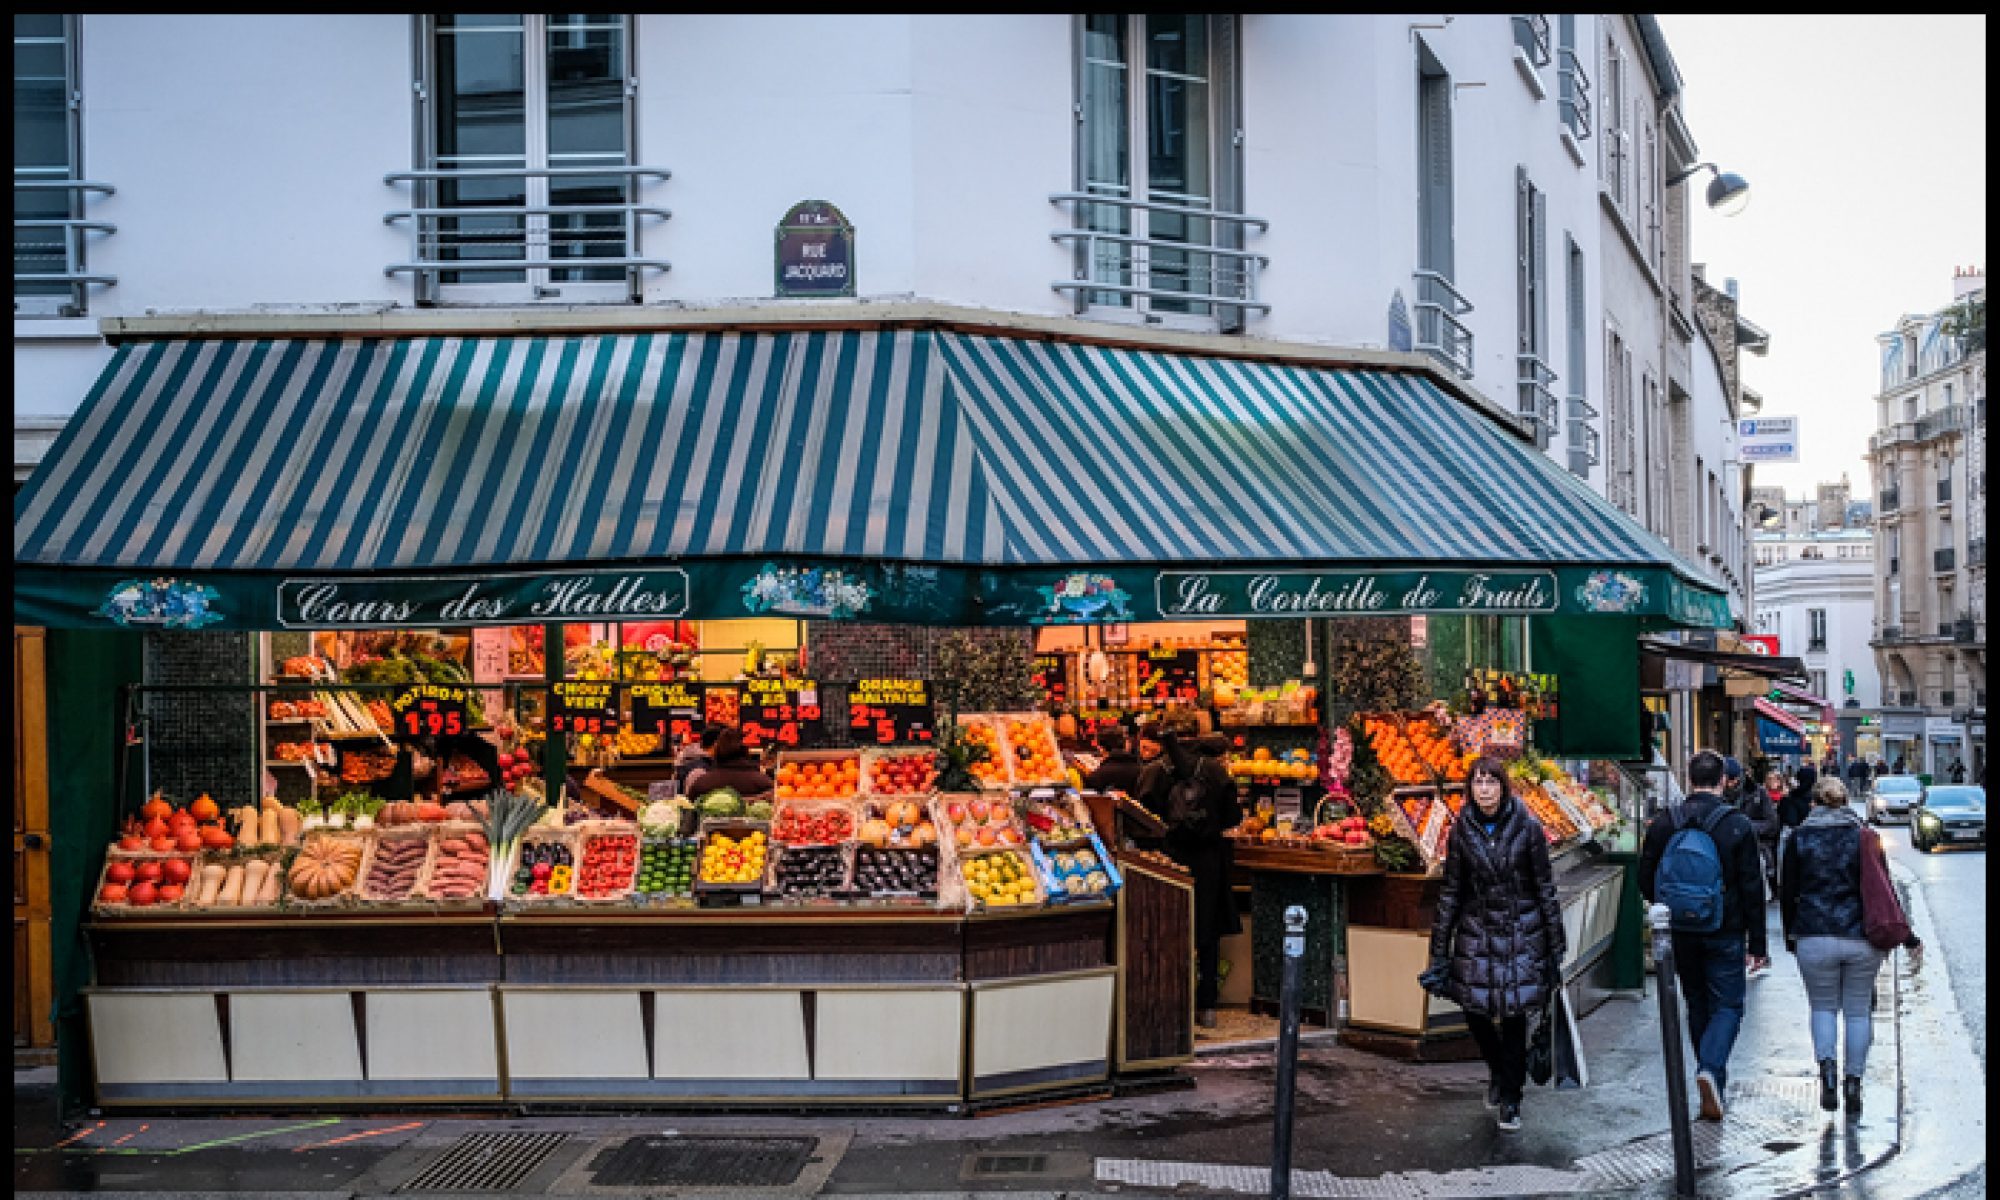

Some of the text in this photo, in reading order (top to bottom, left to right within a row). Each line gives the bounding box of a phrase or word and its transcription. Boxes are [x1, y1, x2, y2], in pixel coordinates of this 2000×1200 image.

[802, 243, 826, 258] RUE
[785, 263, 847, 281] JACQUARD
[297, 575, 680, 623] Cours des Halles
[1170, 573, 1550, 614] La Corbeille de Fruits
[553, 682, 611, 696] CHOUX
[748, 679, 817, 691] ORANGE
[859, 679, 924, 692] ORANGE
[393, 684, 464, 712] POTIRON
[647, 695, 700, 707] BLANC
[848, 691, 927, 706] MALTAISE
